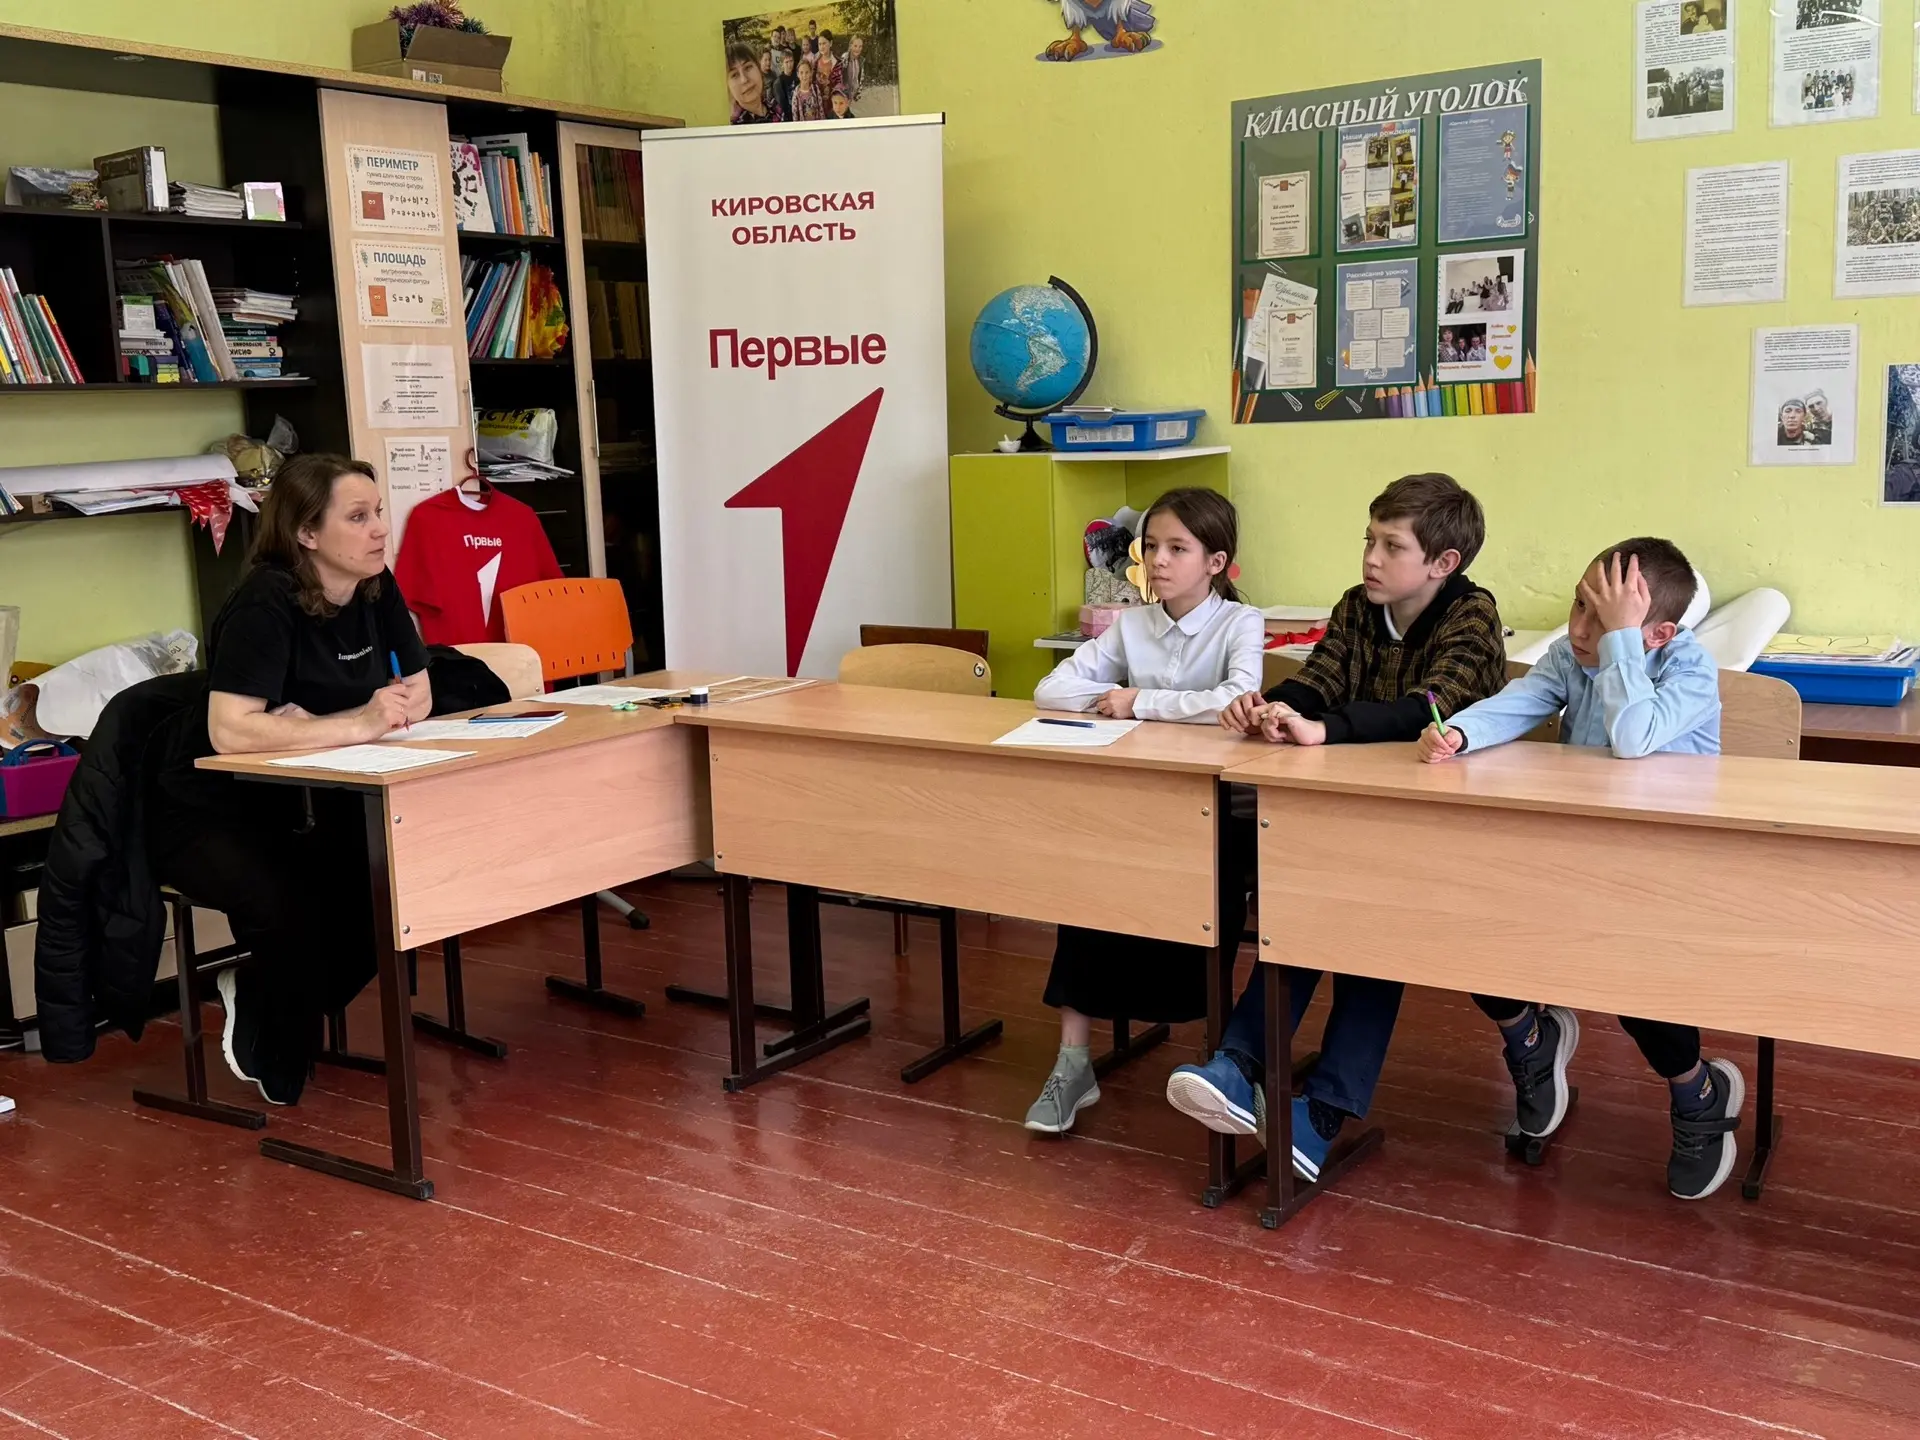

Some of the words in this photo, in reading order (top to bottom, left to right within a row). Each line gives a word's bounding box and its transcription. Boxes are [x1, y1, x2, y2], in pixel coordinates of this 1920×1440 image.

[1243, 87, 1403, 139] КЛАССНЫЙ
[1403, 76, 1529, 117] УГОЛОК
[366, 156, 419, 171] ПЕРИМЕТР
[711, 191, 875, 217] КИРОВСКАЯ
[732, 222, 856, 245] ОБЛАСТЬ
[374, 252, 426, 267] ПЛОЩАДЬ
[709, 328, 887, 380] Первые
